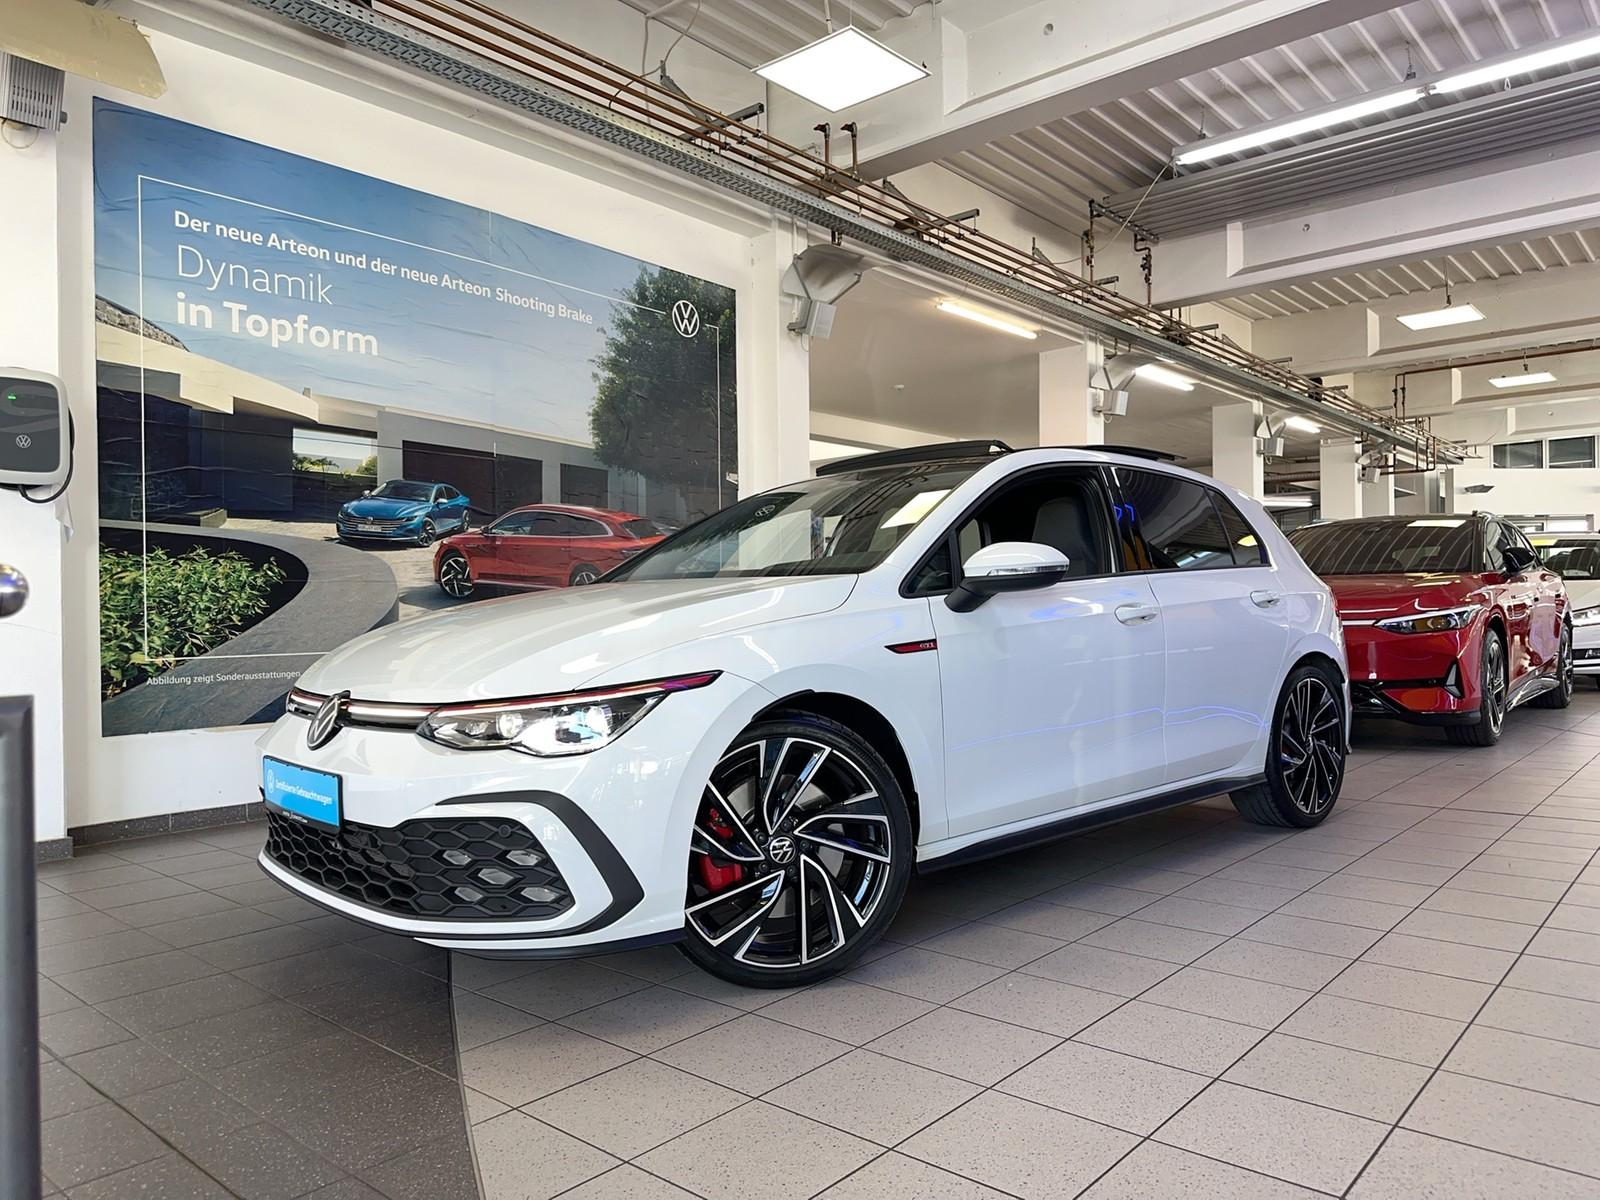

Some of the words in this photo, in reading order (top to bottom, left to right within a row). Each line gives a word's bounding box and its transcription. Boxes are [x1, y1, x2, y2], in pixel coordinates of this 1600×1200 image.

[174, 210, 211, 233] Der
[215, 223, 263, 246] neue
[267, 233, 330, 261] Arteon
[335, 252, 367, 269] und
[371, 258, 398, 276] der
[401, 265, 438, 286] neue
[441, 274, 492, 298] Arteon
[495, 287, 556, 317] Shooting
[558, 303, 593, 325] Brake
[177, 244, 334, 305] Dynamik
[176, 291, 213, 330] in
[223, 301, 379, 356] Topform
[146, 676, 192, 686] Abbildung
[193, 674, 214, 684] zeigt
[216, 671, 301, 682] Sonderausstattungen
